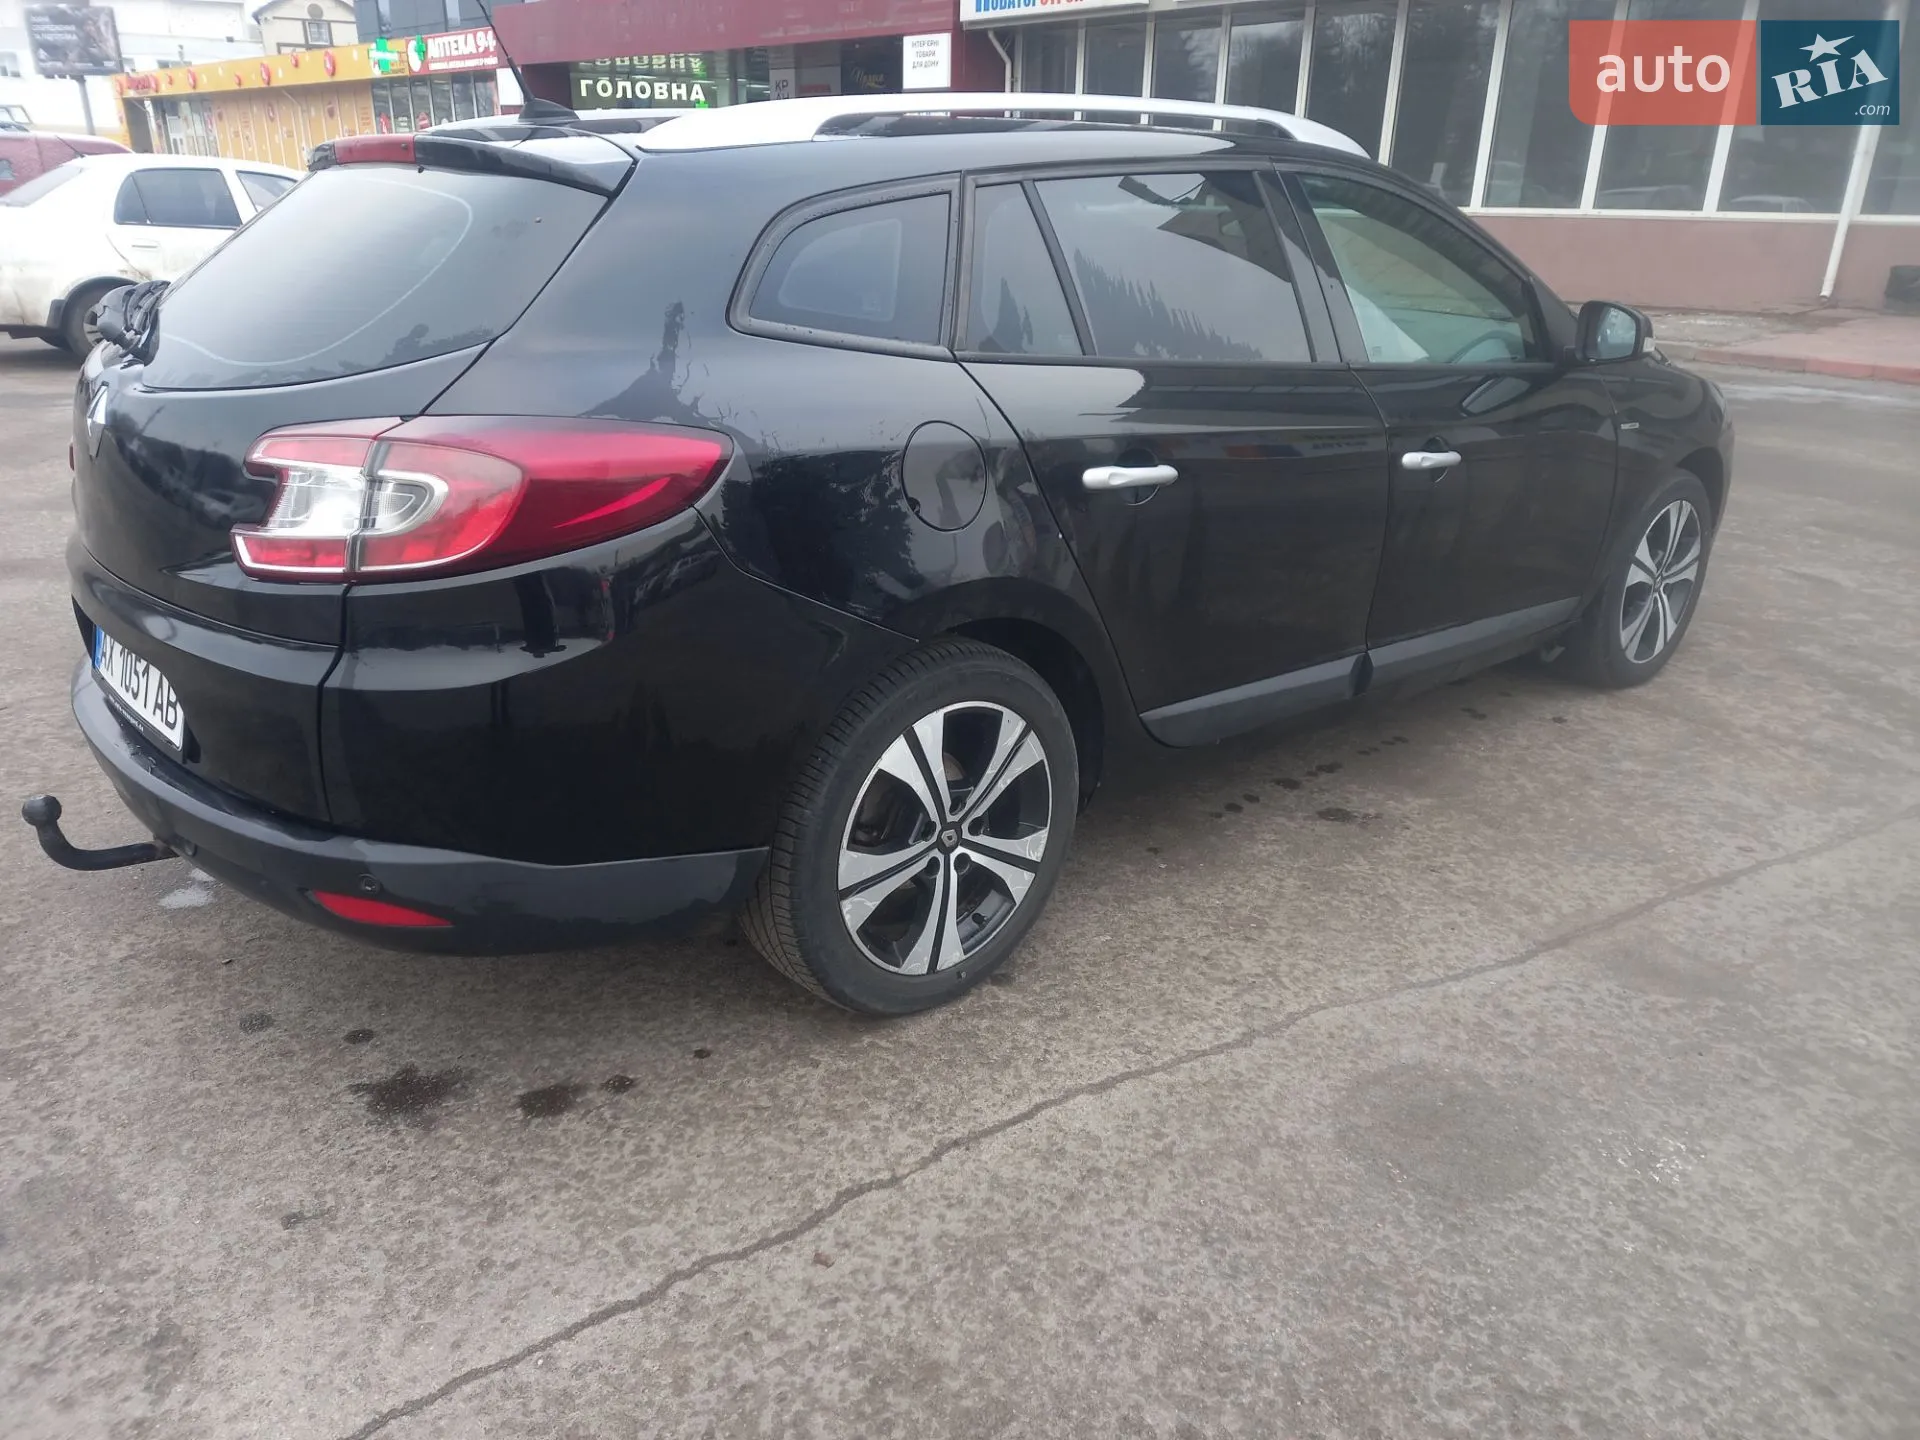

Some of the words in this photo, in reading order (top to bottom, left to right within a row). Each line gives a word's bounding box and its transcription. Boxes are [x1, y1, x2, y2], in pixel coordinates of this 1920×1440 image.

[427, 33, 477, 59] АПТЕКА
[580, 79, 706, 102] ГОЛОВНА
[119, 648, 151, 710] 1051
[152, 671, 178, 731] AB
